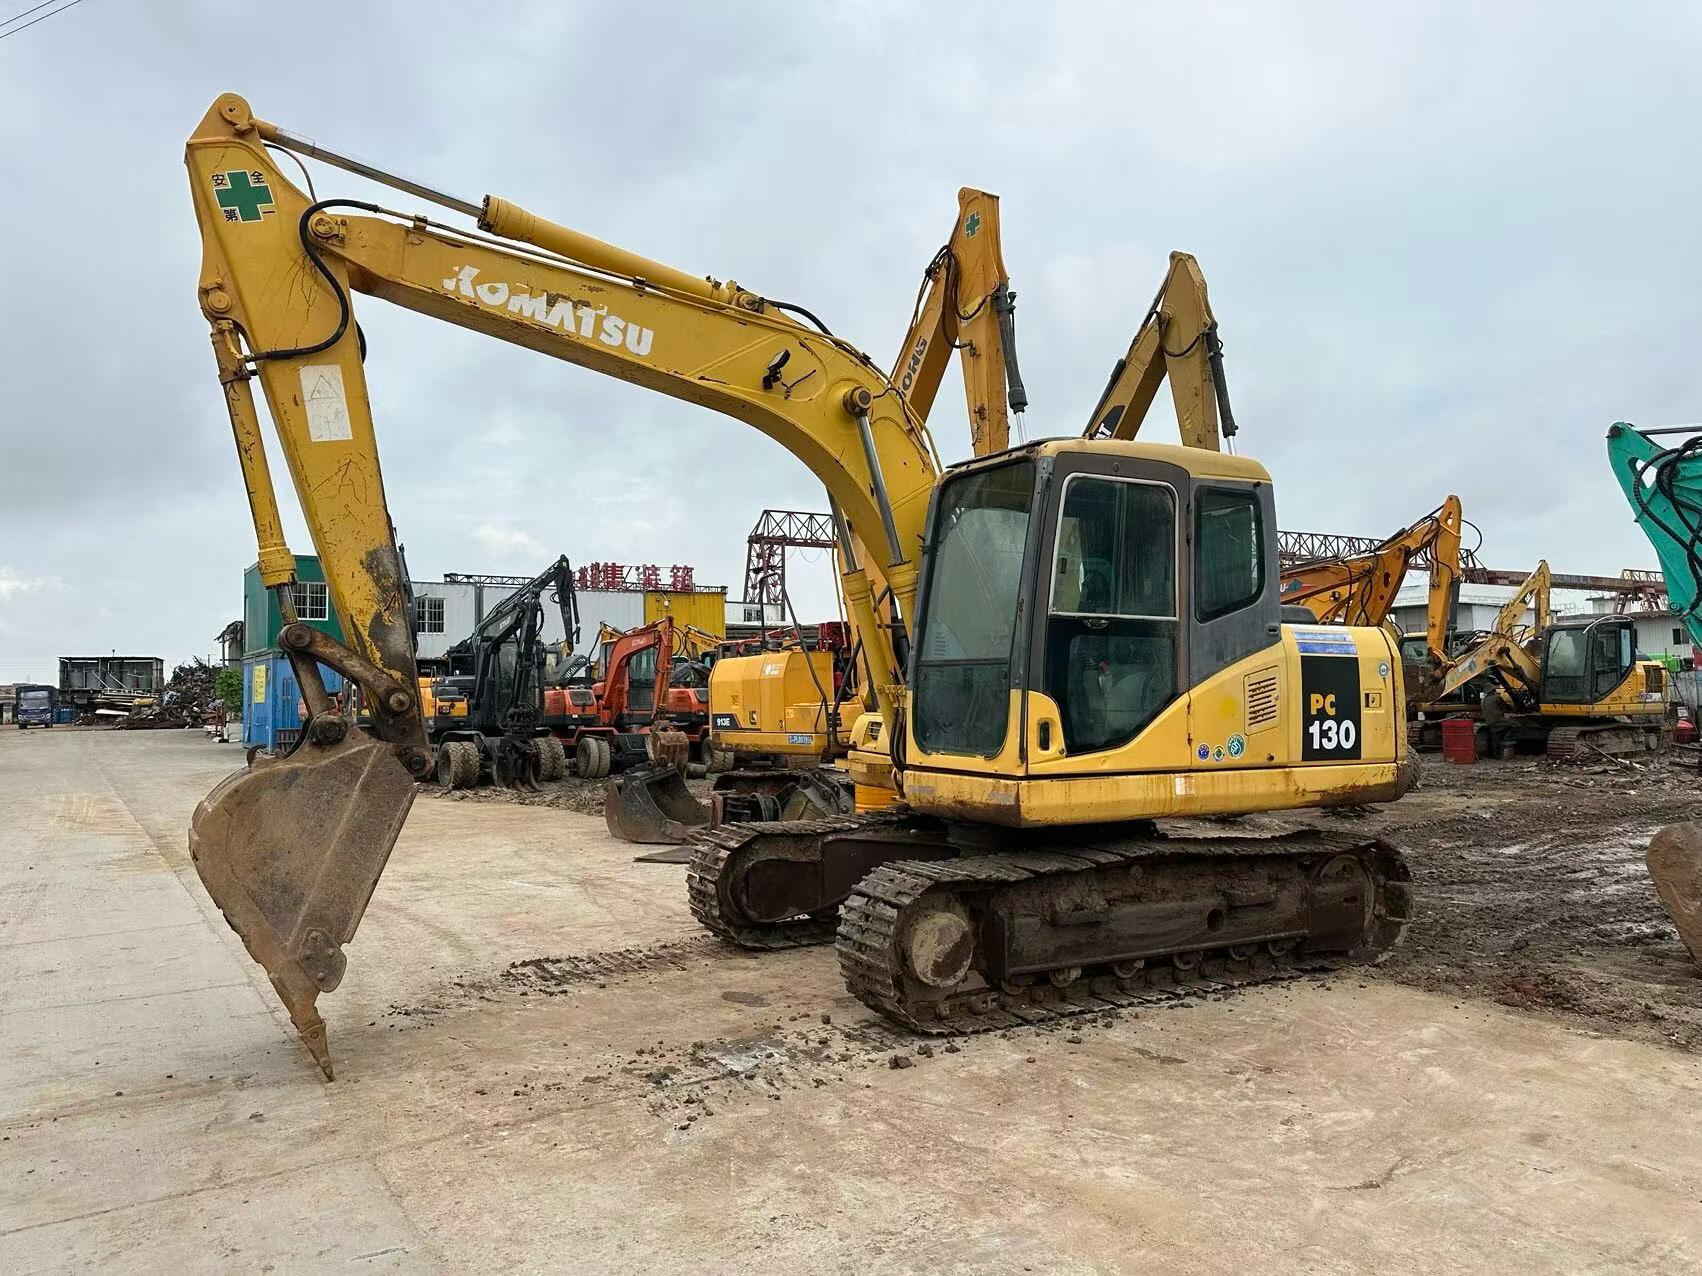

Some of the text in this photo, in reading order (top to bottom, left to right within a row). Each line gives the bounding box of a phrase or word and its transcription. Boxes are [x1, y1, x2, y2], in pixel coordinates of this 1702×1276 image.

[442, 265, 654, 356] KOMATSU
[1310, 693, 1336, 716] PC
[716, 717, 731, 727] 913E
[1308, 719, 1356, 750] 130
